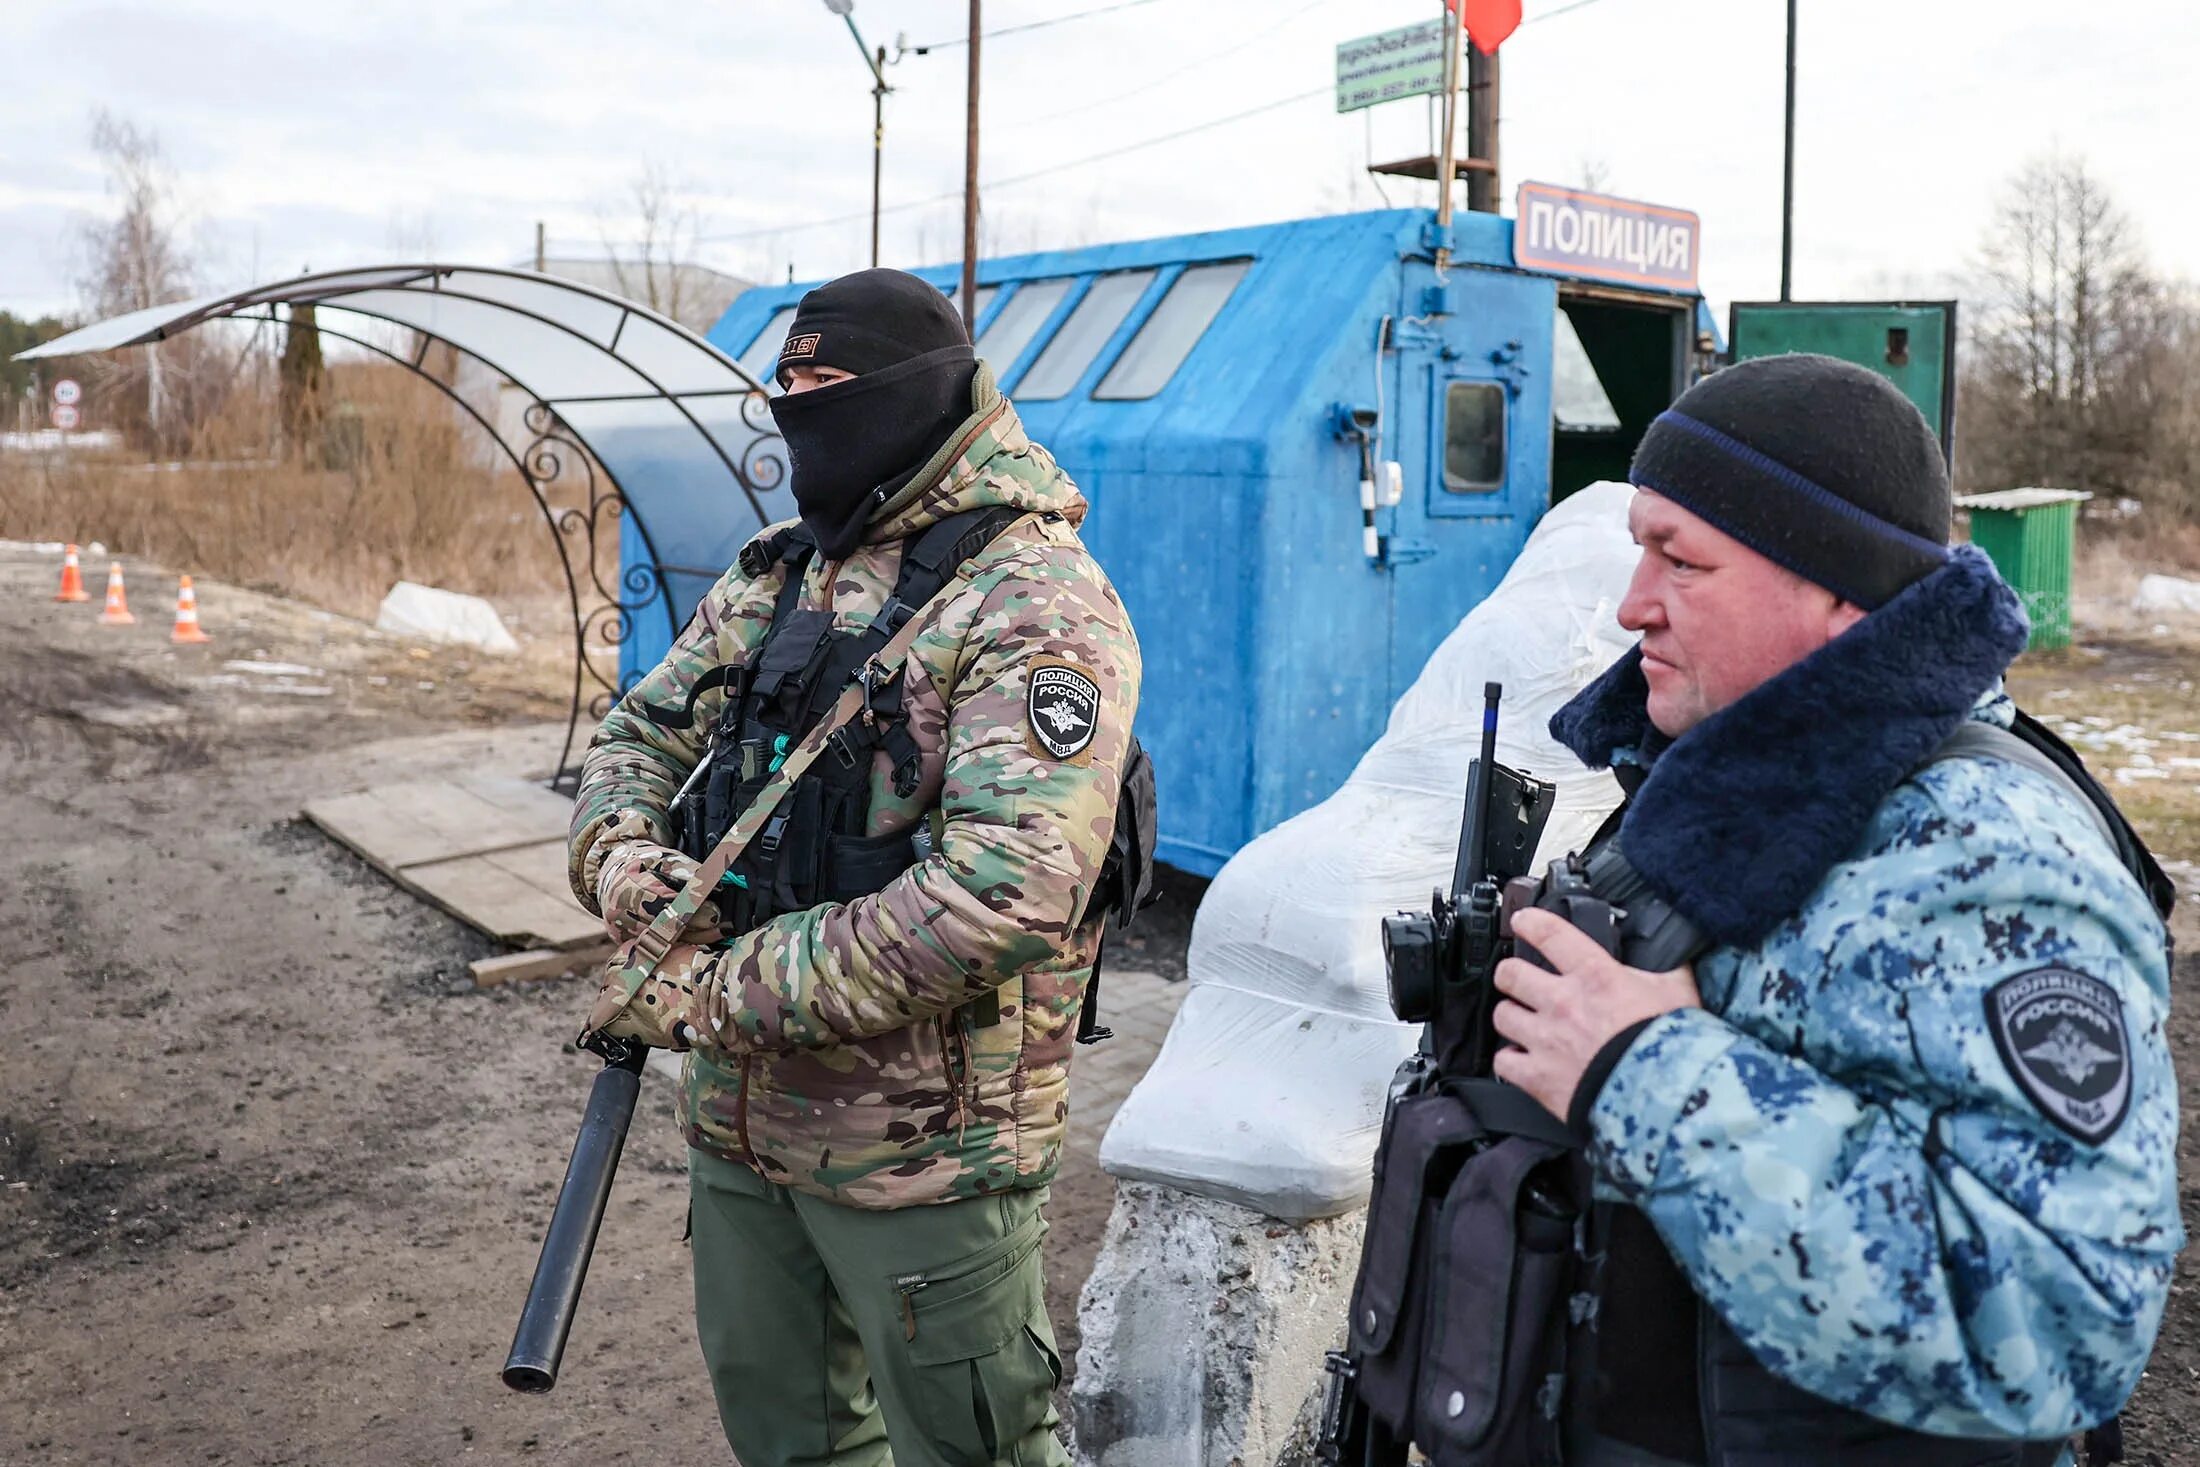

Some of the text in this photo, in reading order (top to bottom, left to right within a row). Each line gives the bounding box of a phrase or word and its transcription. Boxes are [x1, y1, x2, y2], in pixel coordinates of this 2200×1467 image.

[1529, 200, 1690, 273] ПОЛИЦИЯ
[1039, 671, 1093, 697] ПОЛИЦИЯ
[1039, 686, 1089, 711] РОССИЯ
[1049, 740, 1071, 755] МВД
[2004, 975, 2113, 1010] ПОЛИЦИЯ
[2016, 998, 2109, 1033] РОССИЯ
